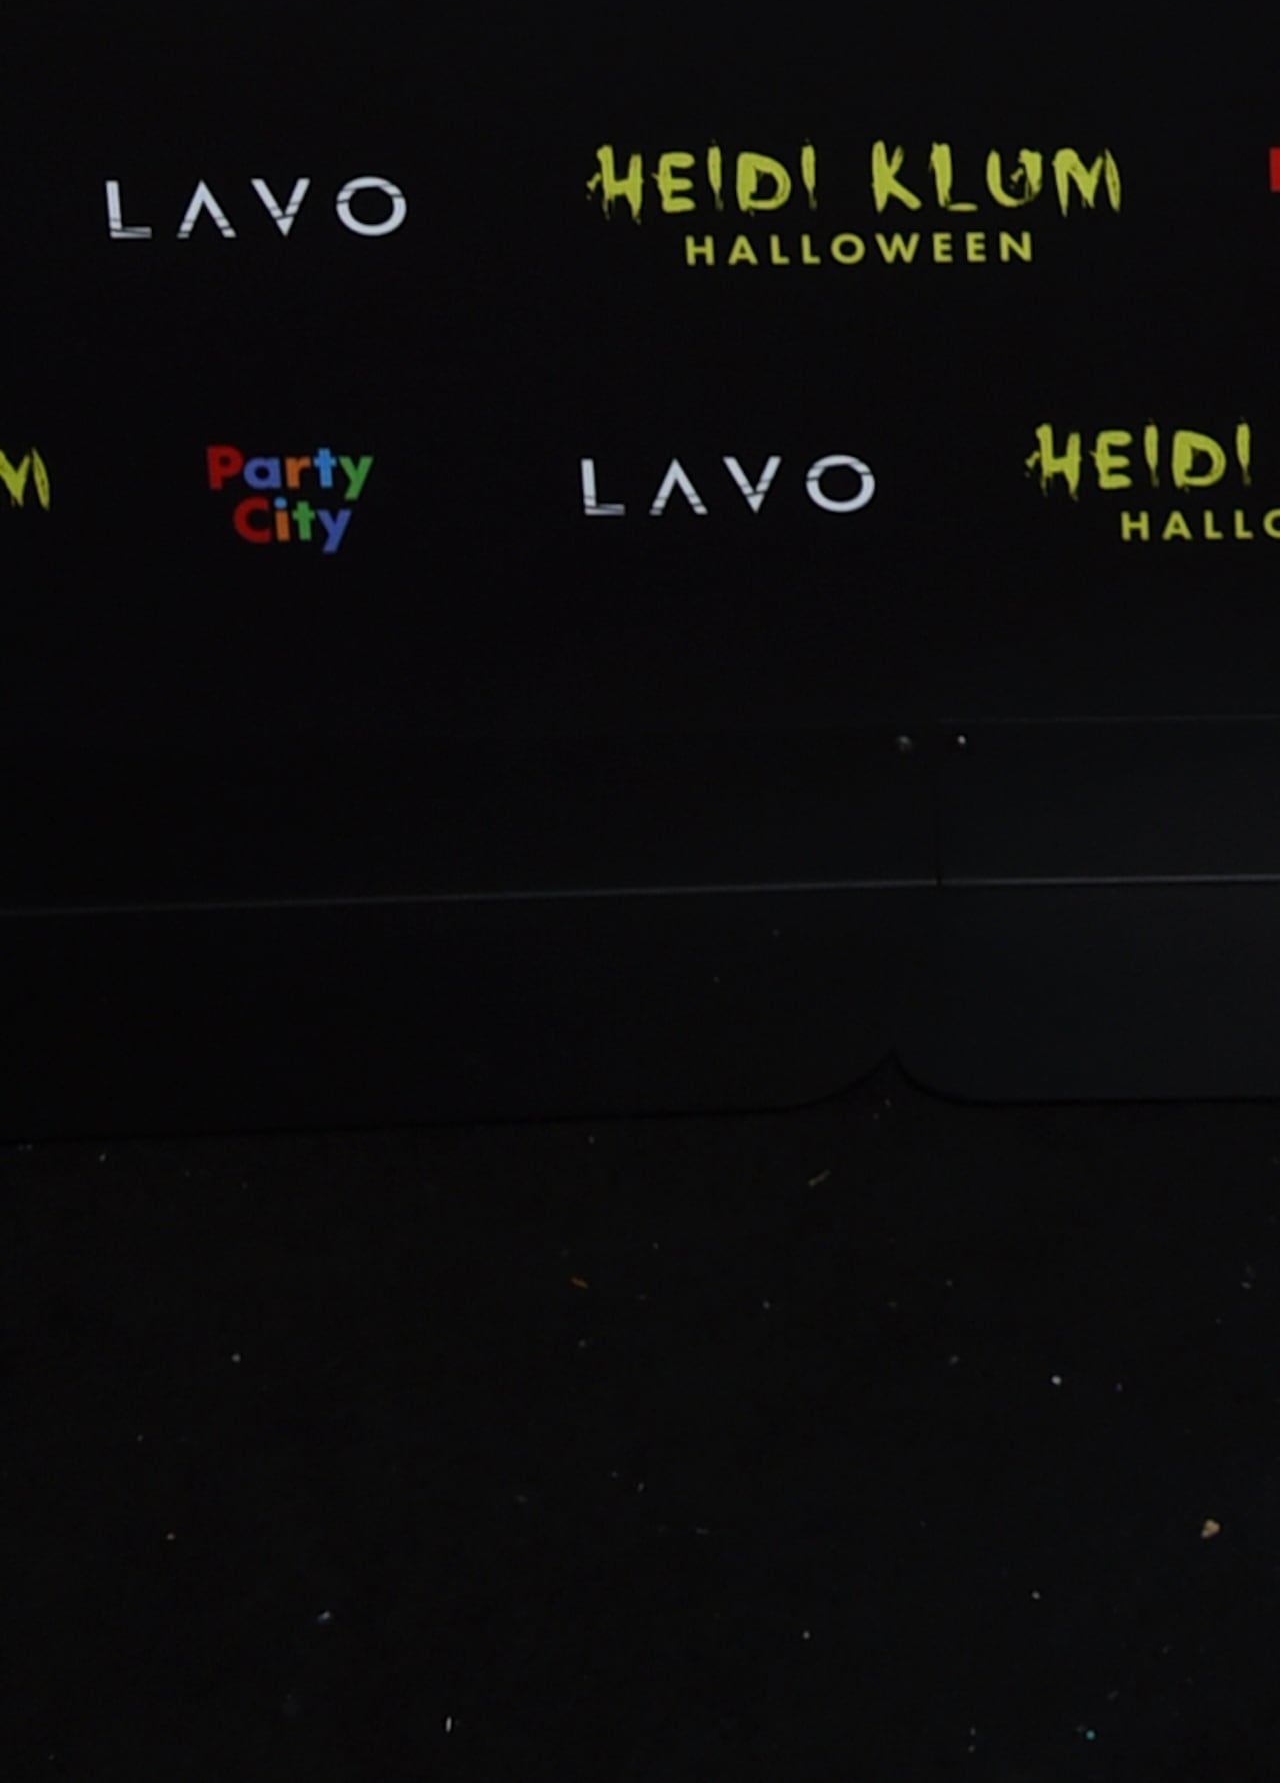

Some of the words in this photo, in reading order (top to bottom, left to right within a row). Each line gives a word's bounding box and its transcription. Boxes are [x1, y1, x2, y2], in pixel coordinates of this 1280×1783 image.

[106, 177, 407, 238] LAVO
[587, 145, 816, 223] HEIDI
[872, 141, 1121, 216] KLUM
[686, 231, 1031, 265] HALLOWEEN
[207, 445, 372, 499] Party
[581, 455, 875, 515] LAVO
[1026, 423, 1250, 498] HEIDI
[234, 497, 351, 553] City
